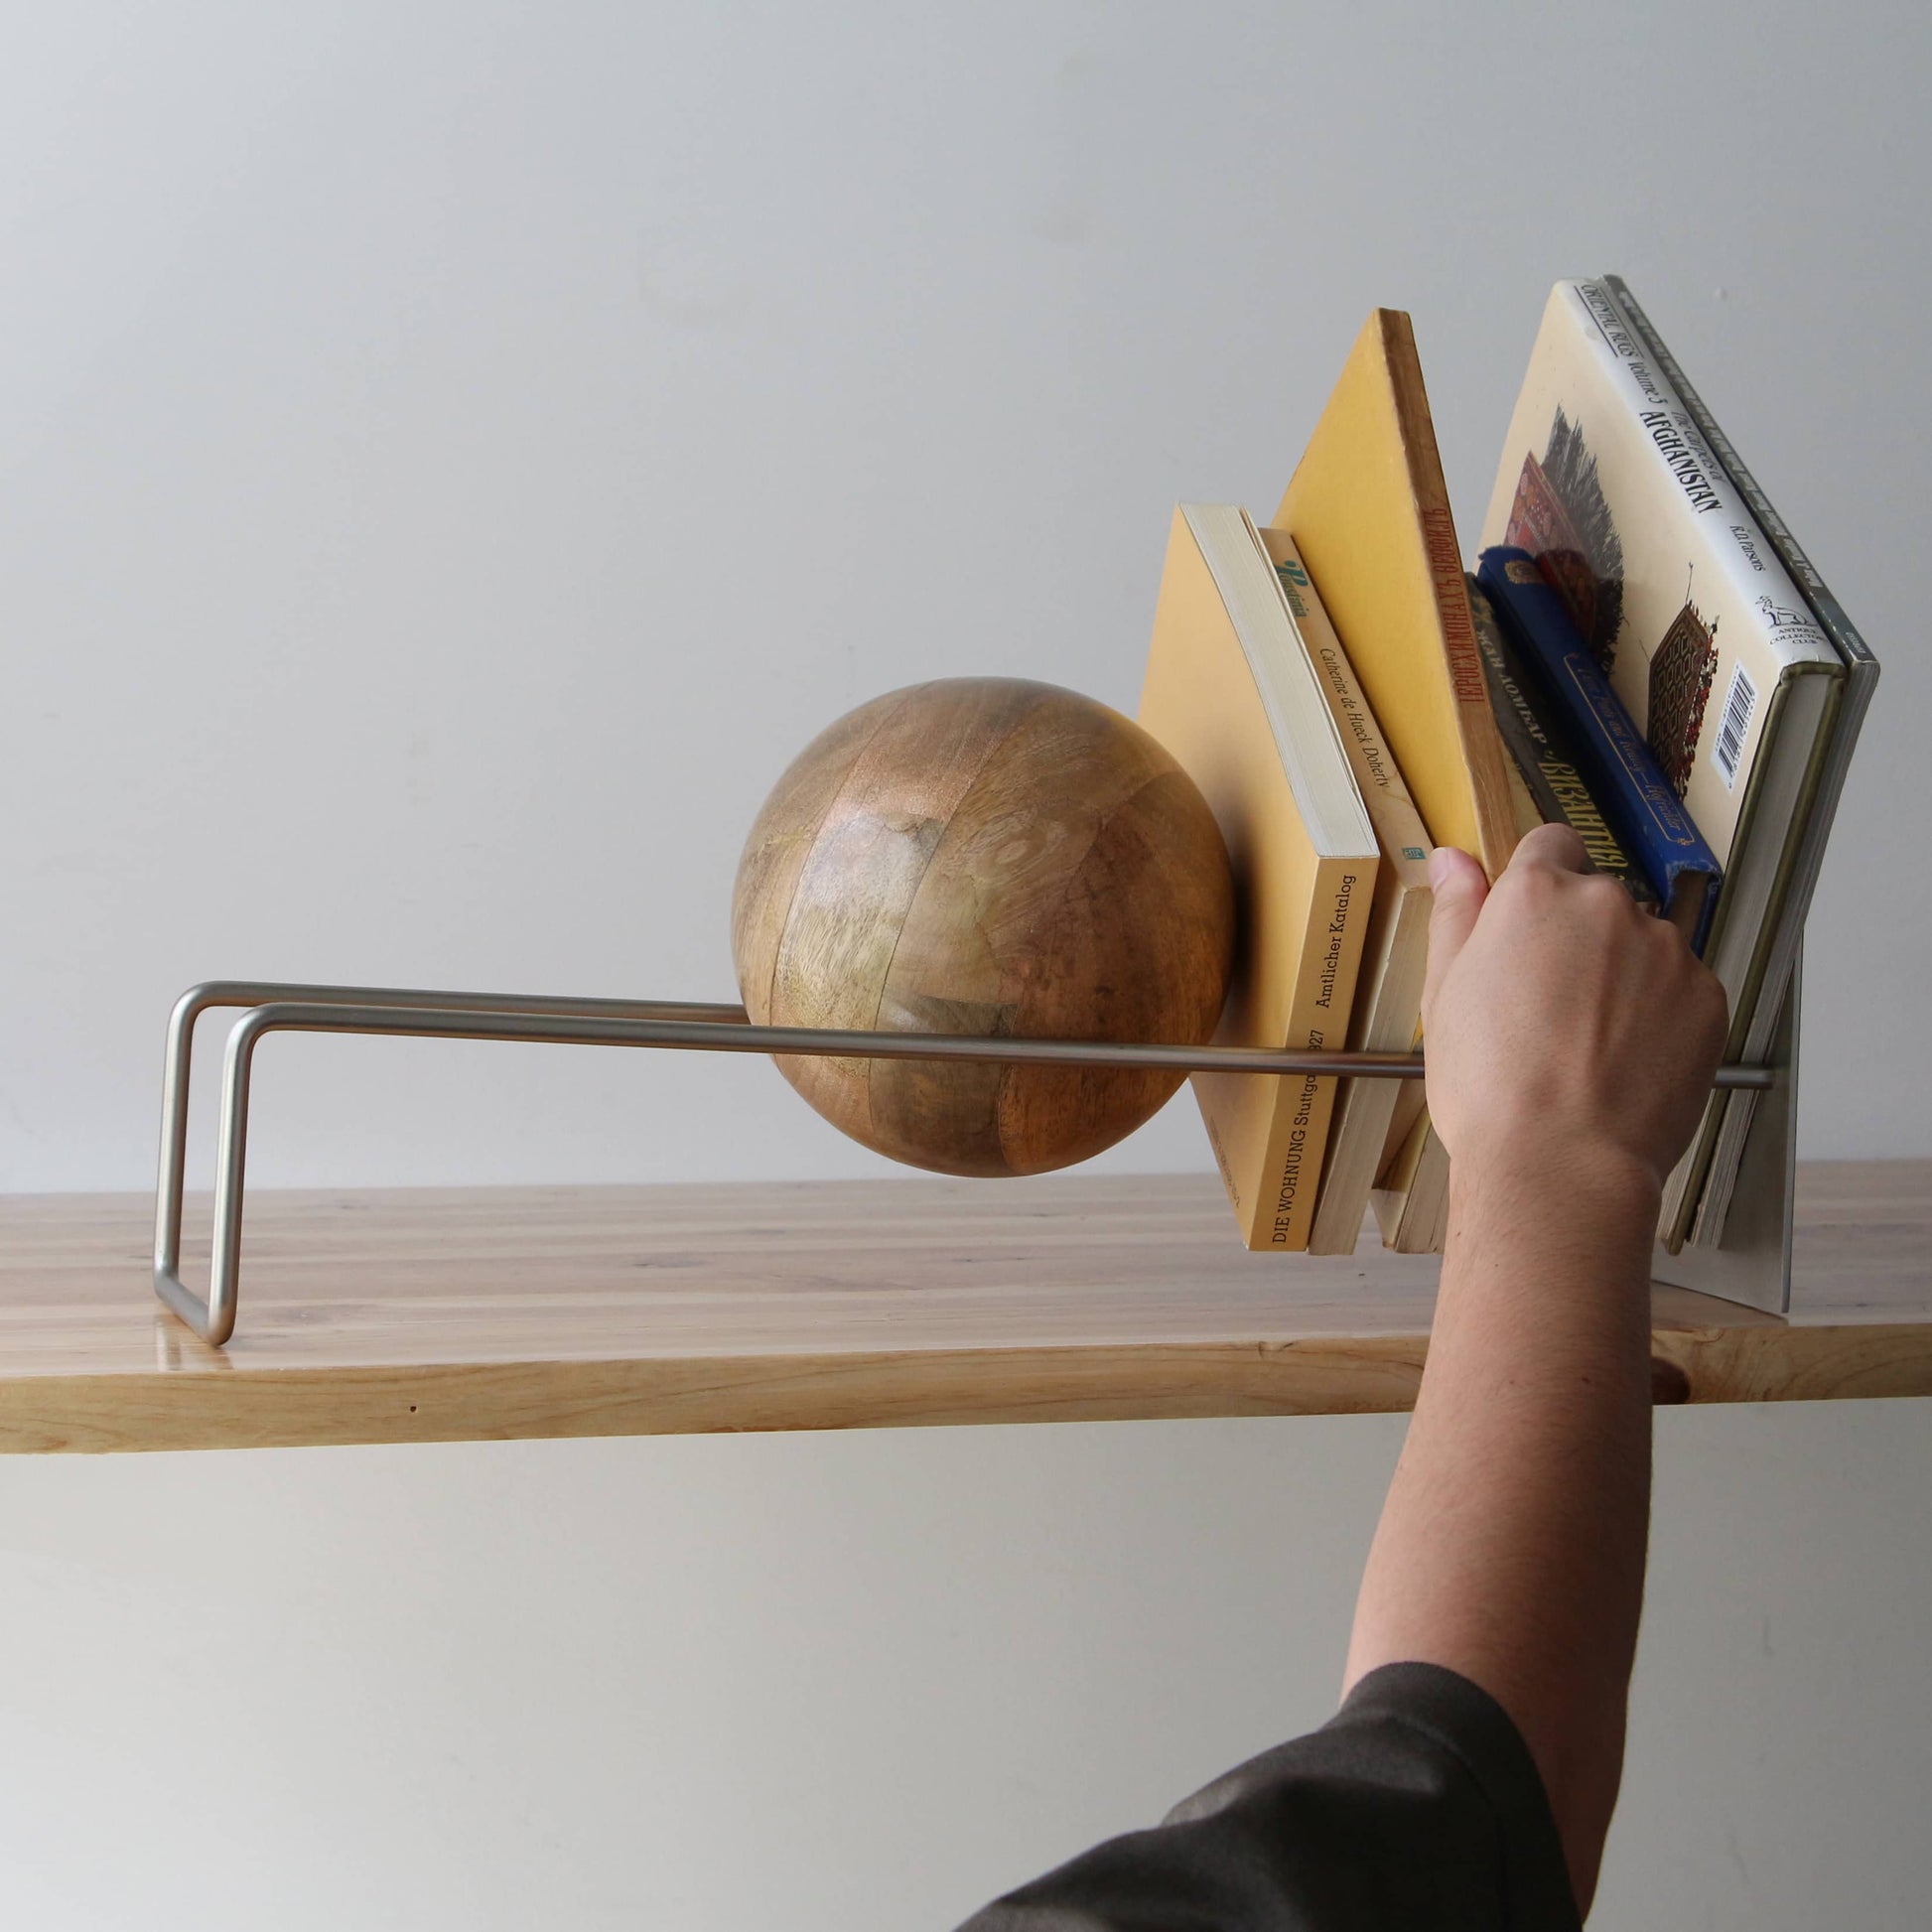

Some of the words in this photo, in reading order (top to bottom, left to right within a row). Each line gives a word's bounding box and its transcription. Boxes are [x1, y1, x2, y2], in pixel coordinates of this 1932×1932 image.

[1582, 284, 1618, 329] ORIENTAL
[1609, 331, 1638, 358] RUGS
[1628, 360, 1658, 397] Volume
[1639, 410, 1724, 514] AFGHANISTAN
[1319, 647, 1348, 696] Catherine
[1341, 696, 1355, 710] de
[1347, 711, 1373, 744] Hueck
[1363, 748, 1390, 789] Doherty
[1538, 760, 1628, 870] ВИЗАНТИЯ
[1328, 875, 1356, 933] Katalog
[1315, 936, 1341, 1009] Amtlicher
[1294, 1074, 1318, 1126] Stuttga
[1278, 1130, 1306, 1213] WOHNUNG
[1273, 1216, 1290, 1243] DIE
